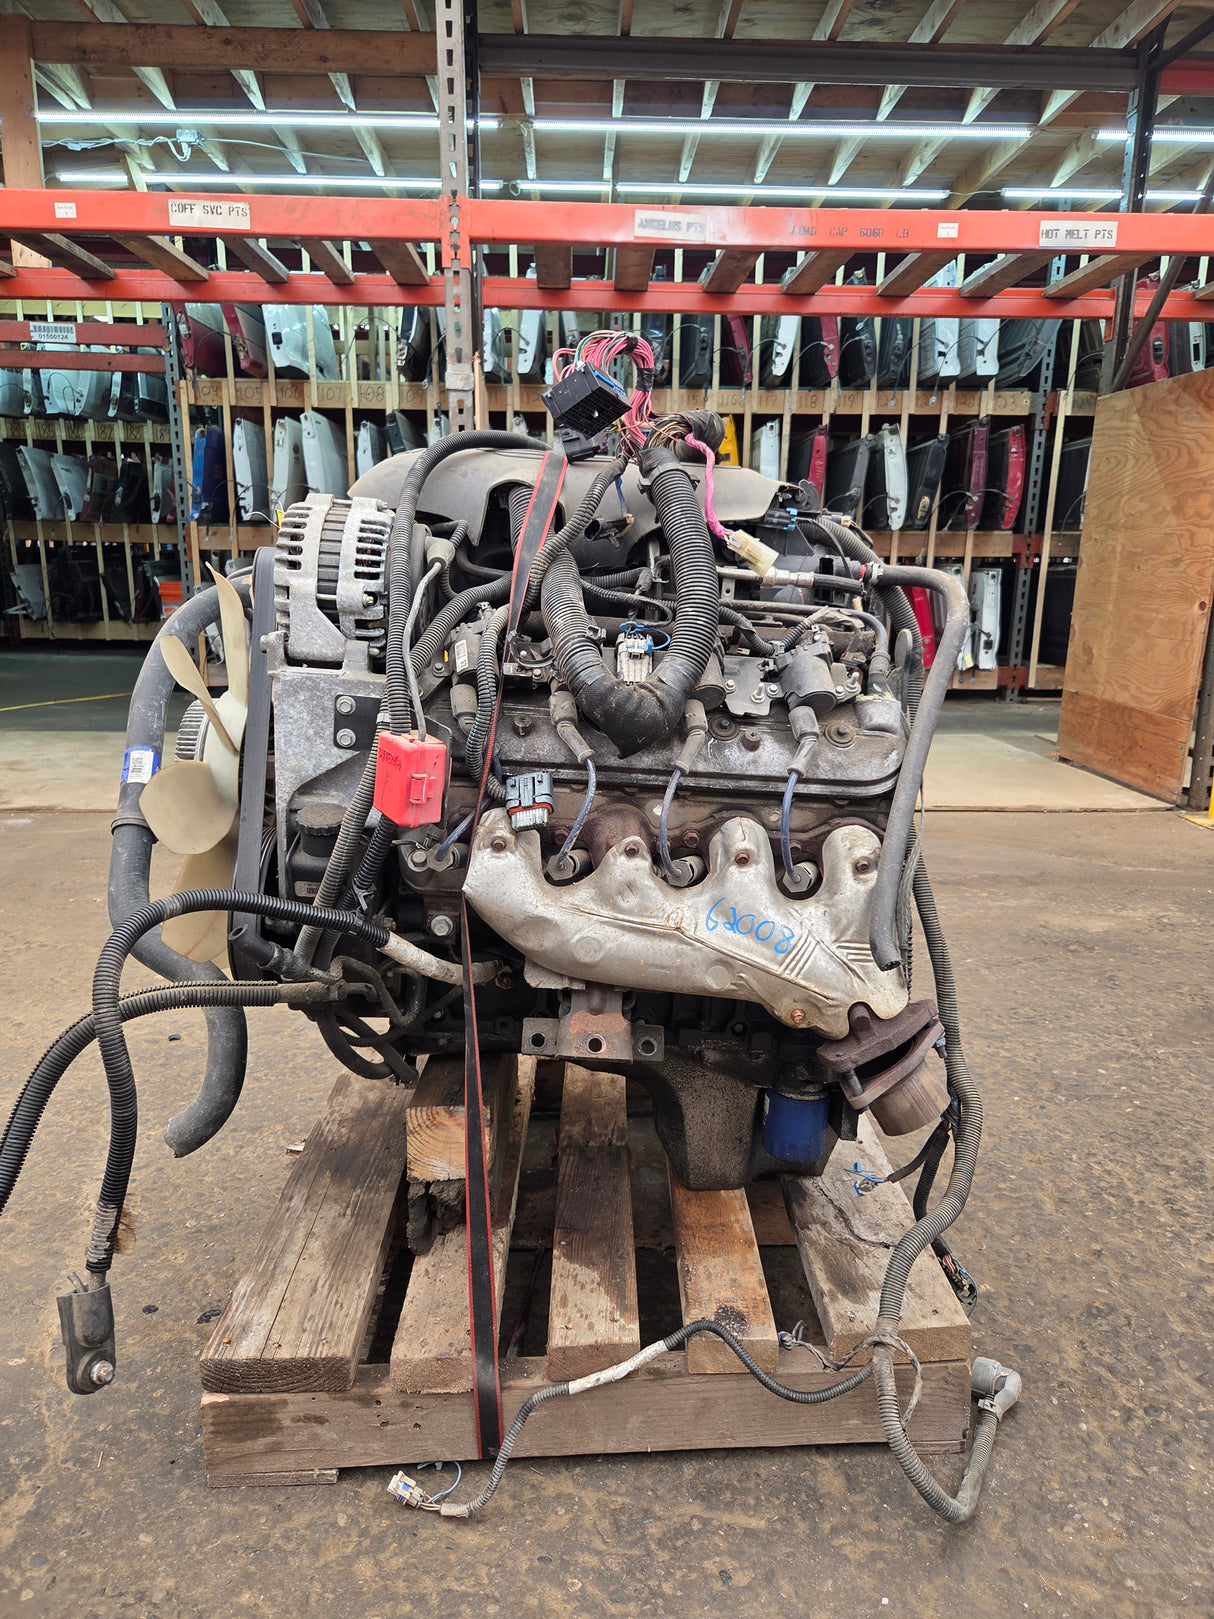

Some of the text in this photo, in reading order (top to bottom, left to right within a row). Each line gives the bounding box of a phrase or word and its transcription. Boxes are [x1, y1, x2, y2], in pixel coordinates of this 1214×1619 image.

[170, 202, 248, 217] COFF SVC PTS
[687, 221, 706, 233] PTS
[791, 225, 817, 236] LOAD
[829, 226, 848, 237] CAP
[896, 228, 909, 239] LB
[1041, 228, 1114, 240] HOT MELT PTS
[320, 386, 343, 401] 107
[360, 386, 385, 402] 108
[721, 393, 737, 407] 116
[759, 394, 778, 408] 117
[799, 394, 818, 409] 118
[705, 897, 795, 955] 62008
